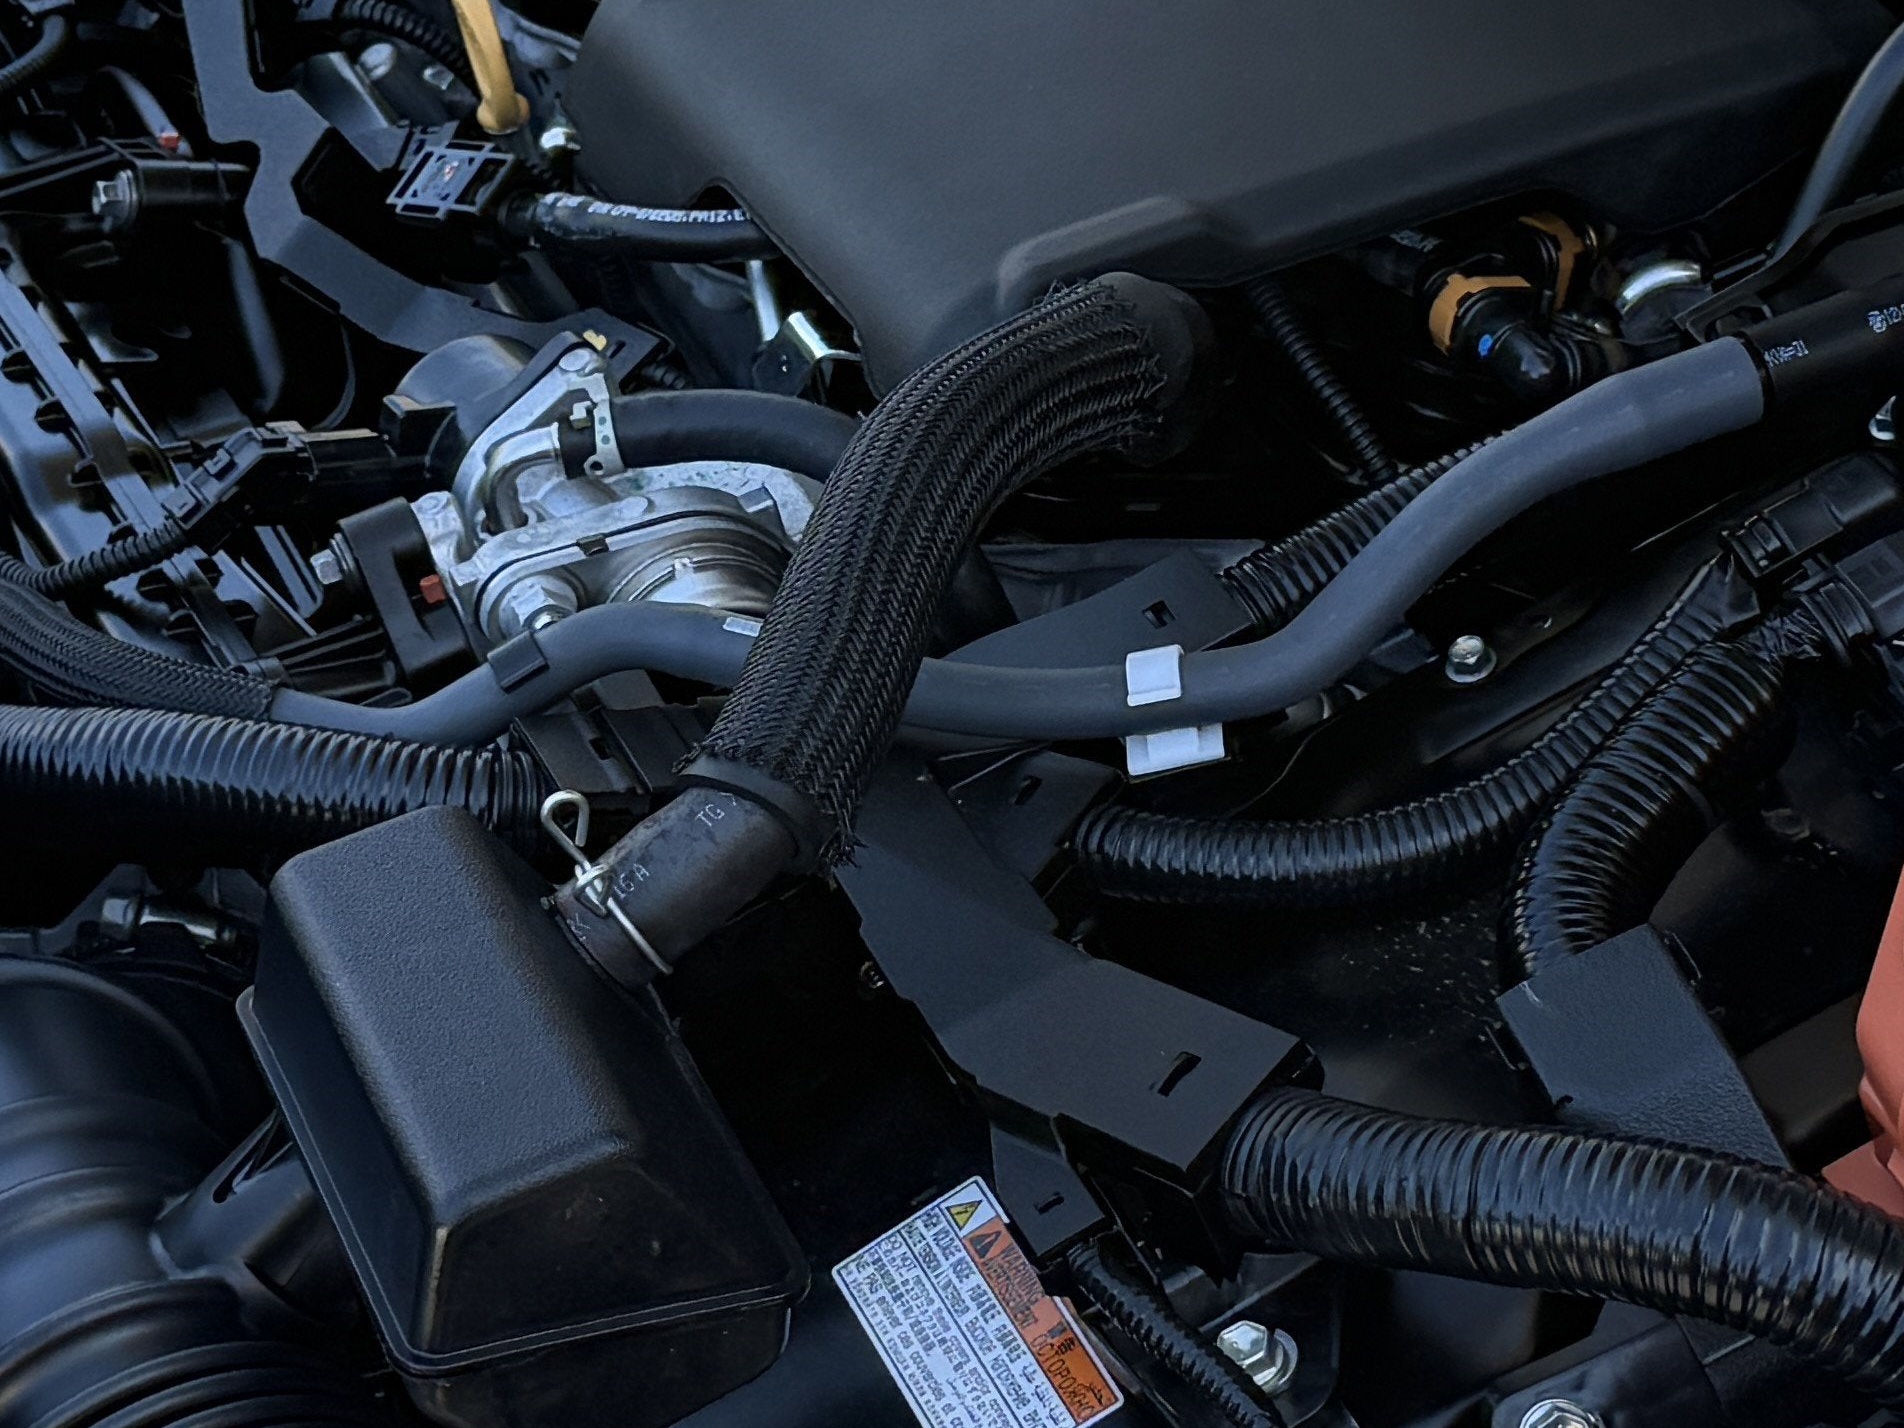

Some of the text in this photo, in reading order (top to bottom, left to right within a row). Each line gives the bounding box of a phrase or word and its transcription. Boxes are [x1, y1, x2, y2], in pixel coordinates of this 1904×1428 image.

[897, 1250, 917, 1273] NOT
[861, 1271, 884, 1295] PAS
[995, 1242, 1047, 1306] WARNING
